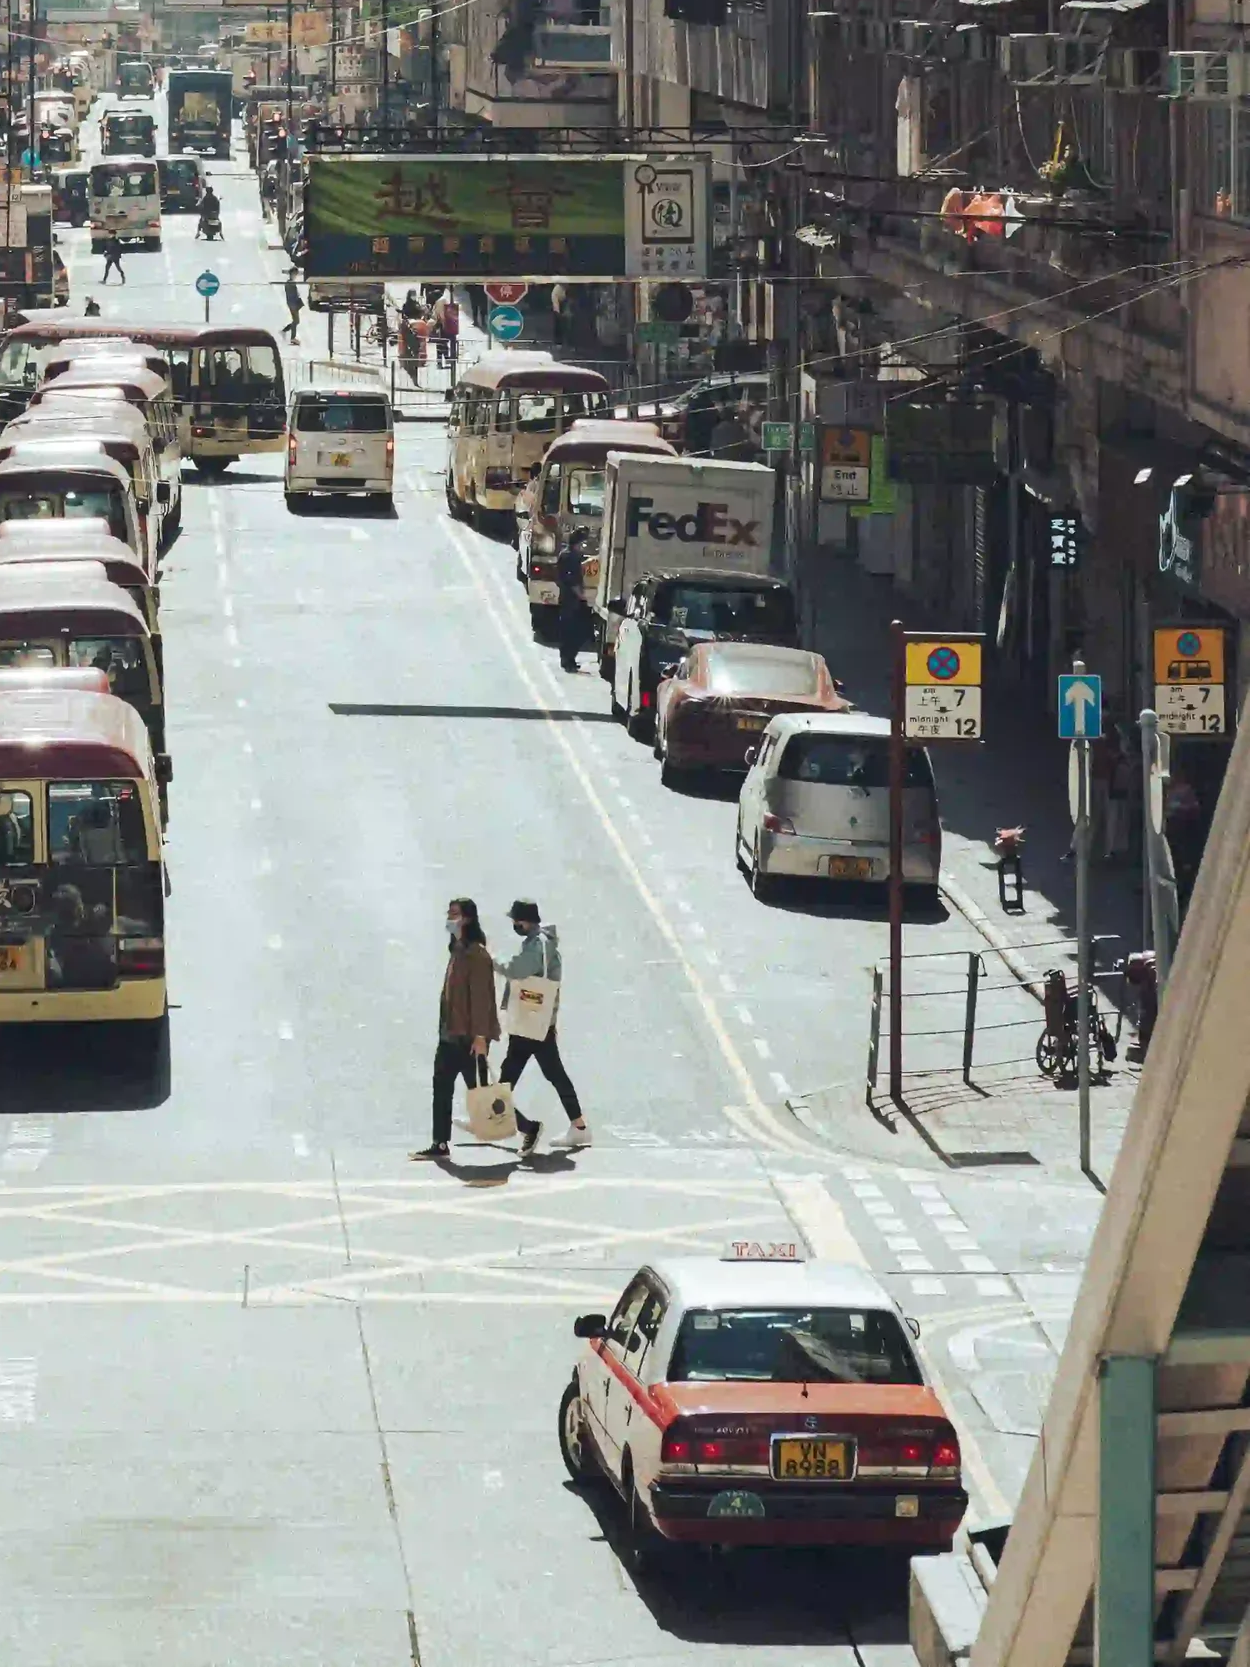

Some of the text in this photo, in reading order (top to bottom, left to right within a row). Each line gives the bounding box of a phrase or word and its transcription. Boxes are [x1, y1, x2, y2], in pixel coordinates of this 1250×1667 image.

[834, 469, 857, 481] End
[628, 497, 761, 547] FedEx
[916, 696, 941, 706] 上午
[953, 688, 966, 707] 7
[1198, 687, 1211, 704] 7
[909, 715, 949, 724] midnight
[954, 718, 977, 736] 12
[1199, 713, 1221, 731] 12
[917, 724, 941, 735] 午夜
[732, 1242, 797, 1258] TAXI
[800, 1441, 827, 1460] VN
